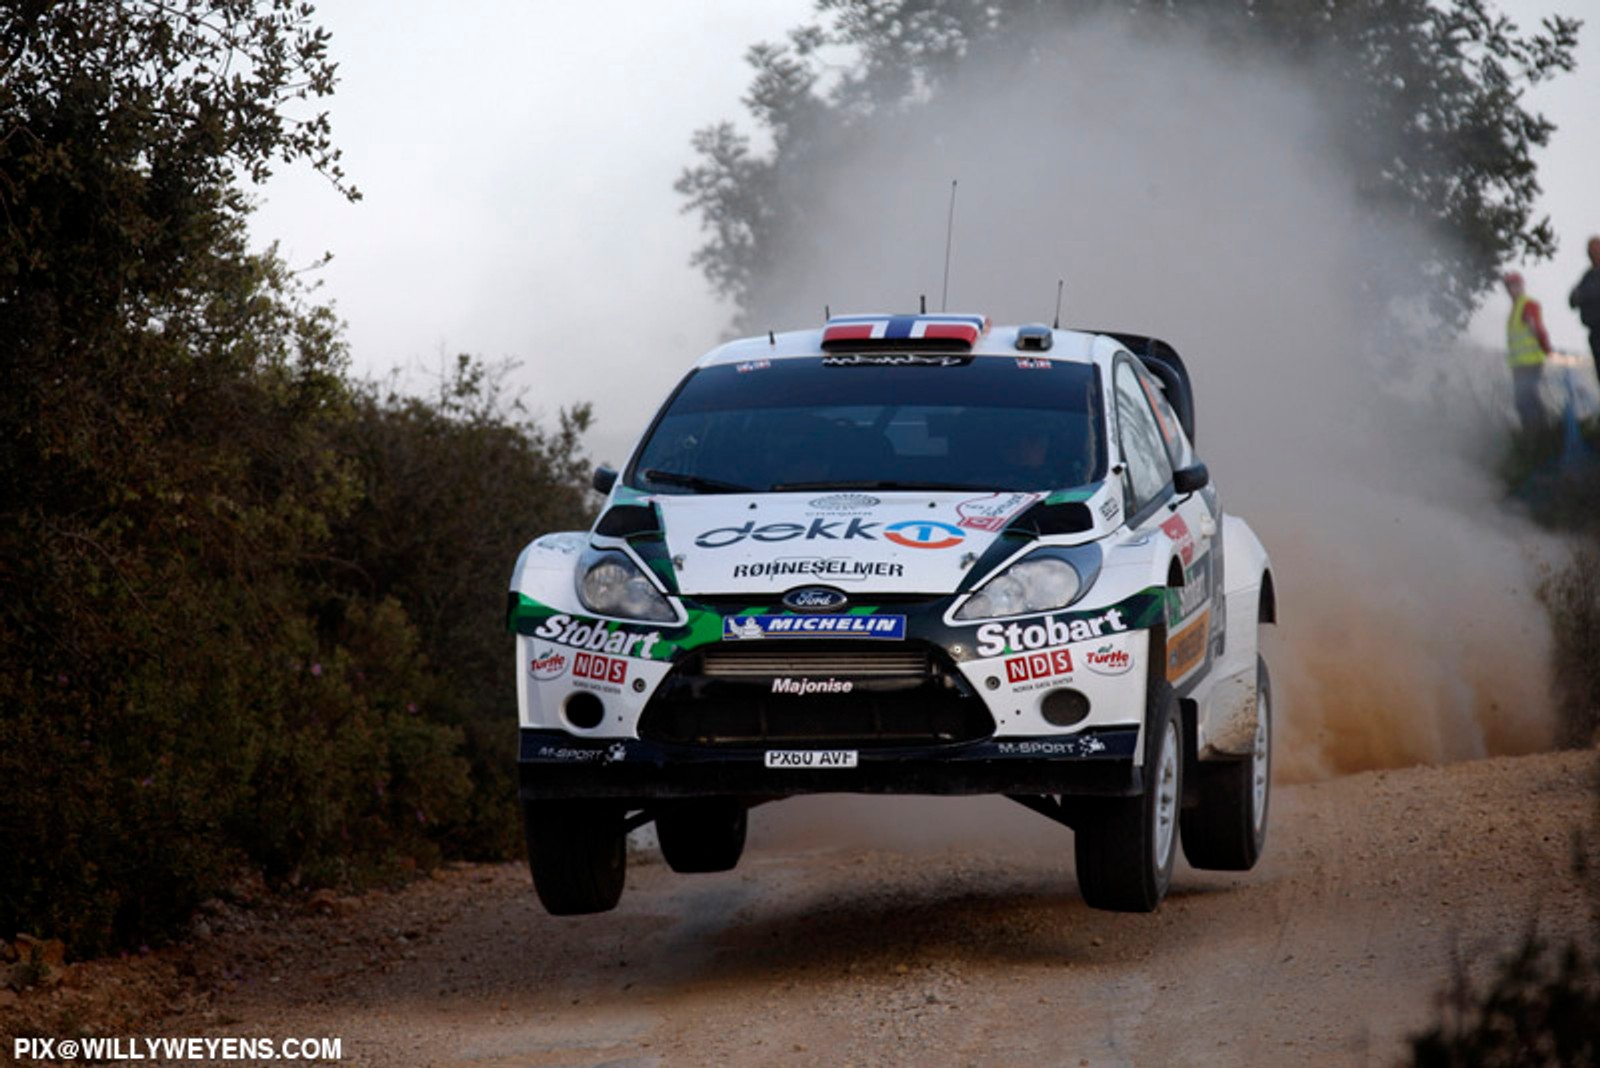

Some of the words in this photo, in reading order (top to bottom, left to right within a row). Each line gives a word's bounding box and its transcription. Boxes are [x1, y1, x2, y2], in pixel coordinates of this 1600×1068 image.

[733, 559, 904, 578] RØHNESELMER
[796, 591, 832, 606] Ford
[768, 618, 896, 633] MICHELIN
[977, 608, 1128, 658] Stobart
[535, 613, 660, 659] Stobart
[1009, 651, 1071, 681] NDS
[1087, 650, 1129, 664] Turtle
[575, 653, 625, 682] NDS
[771, 678, 853, 696] Majonise
[998, 742, 1075, 754] M-SPORT
[769, 751, 814, 766] PX60
